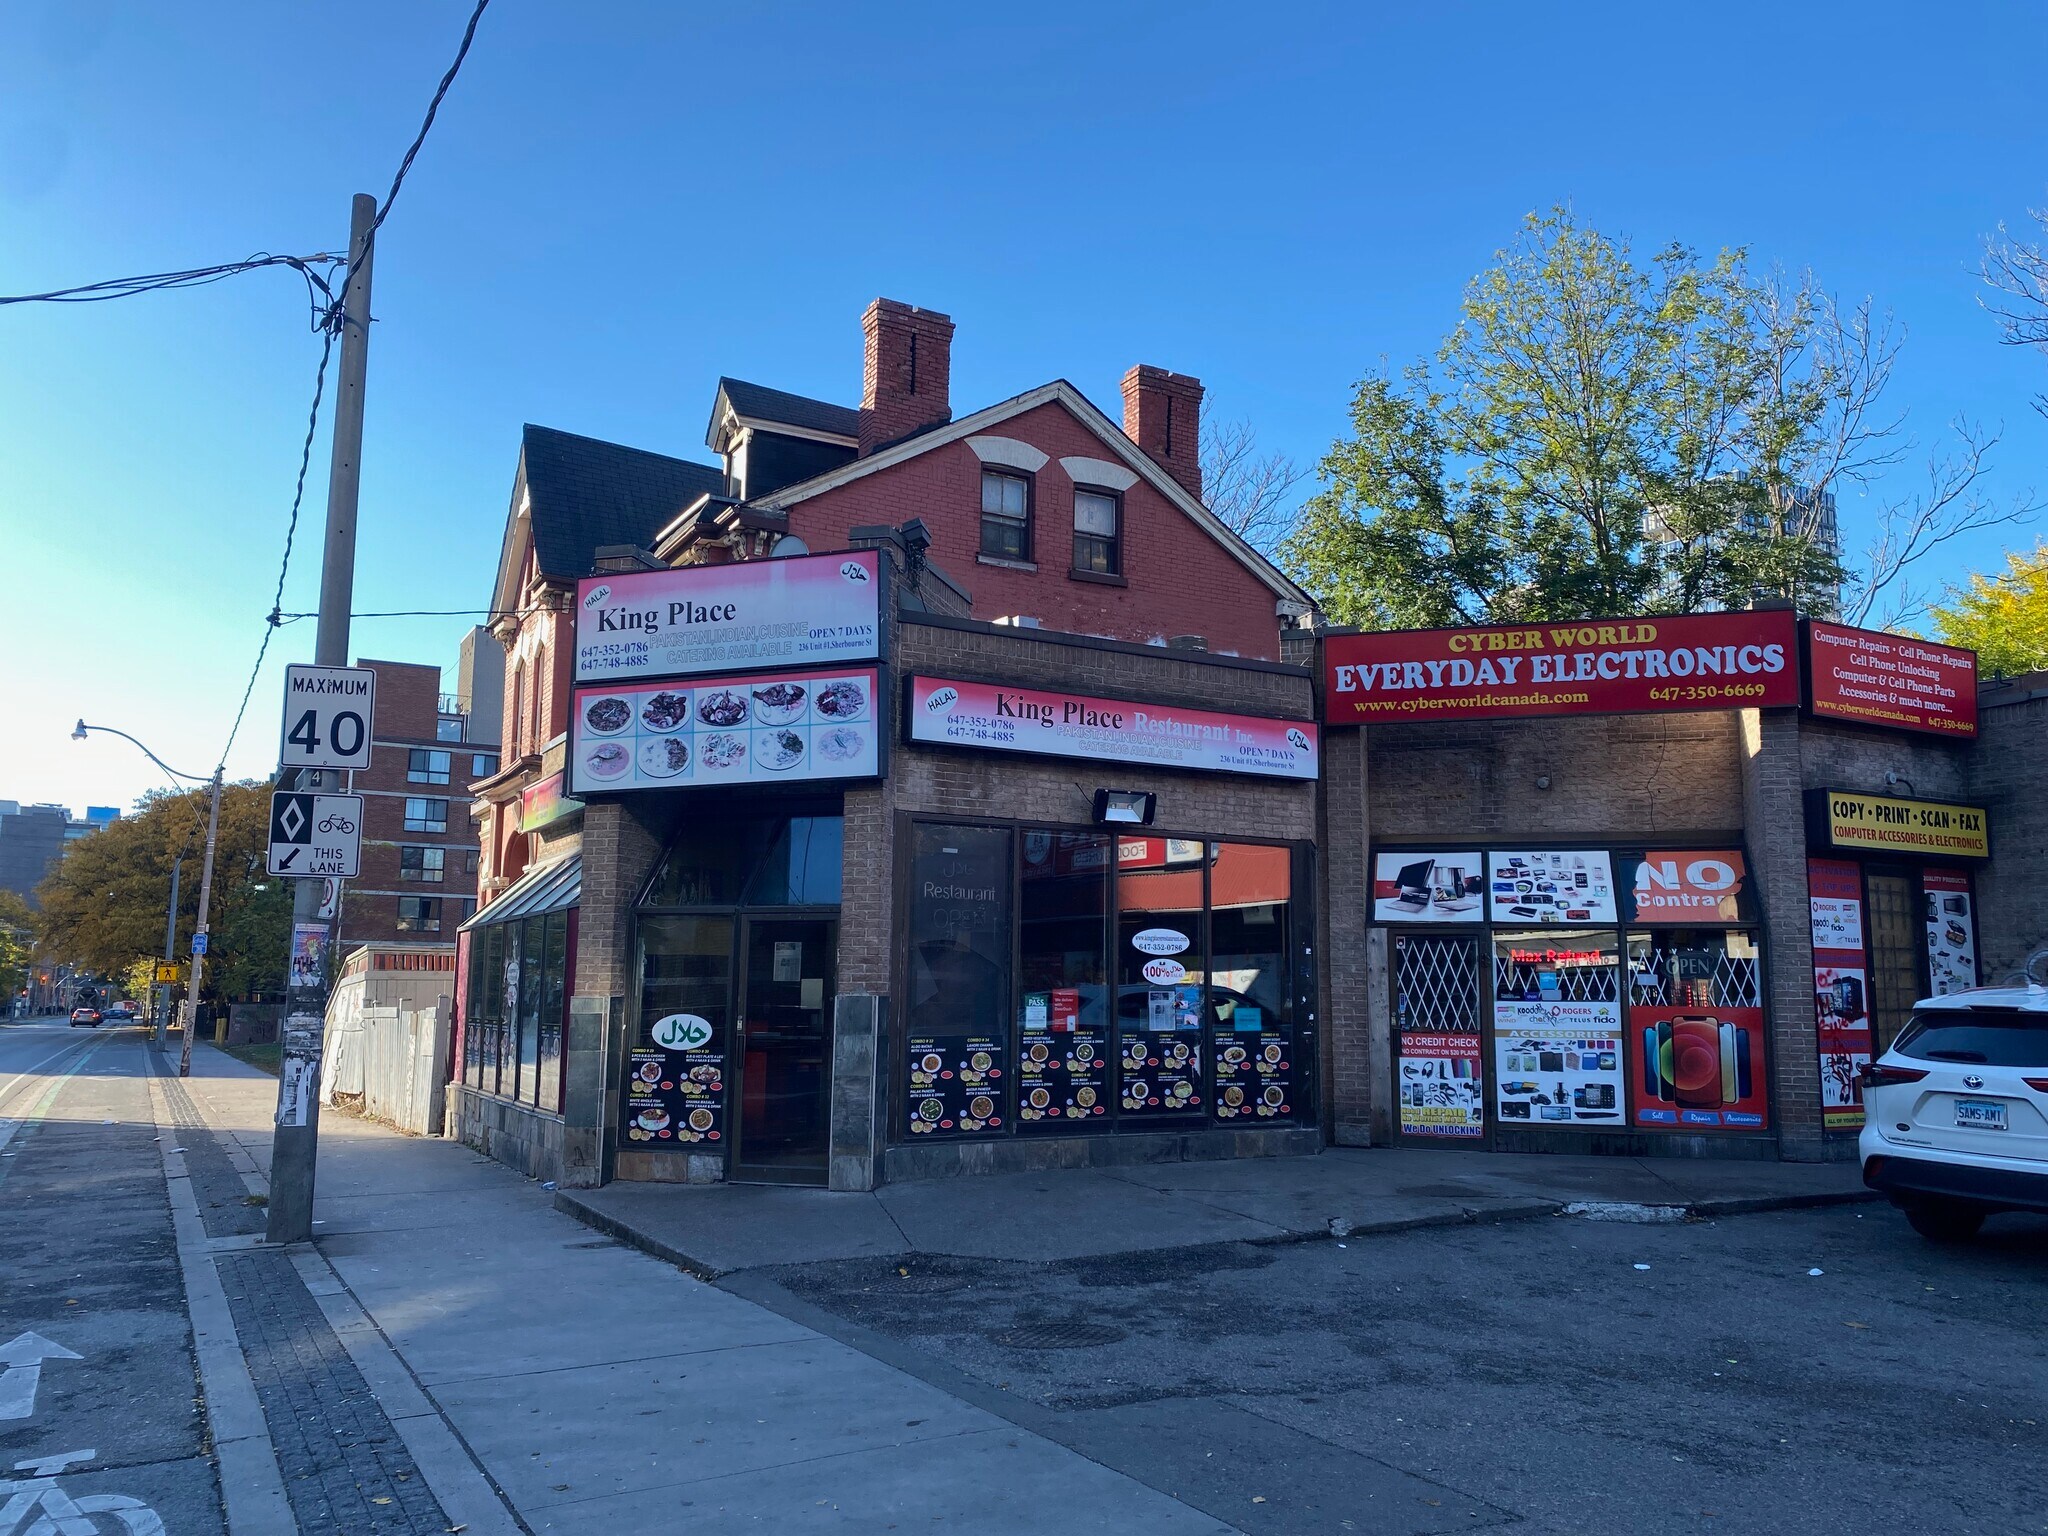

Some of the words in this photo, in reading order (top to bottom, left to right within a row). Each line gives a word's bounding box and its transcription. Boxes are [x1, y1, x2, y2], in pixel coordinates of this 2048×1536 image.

[584, 587, 610, 608] HALAL
[598, 607, 659, 634] King
[668, 602, 737, 626] Place
[809, 628, 836, 639] OPEN
[838, 627, 844, 636] 7
[845, 624, 872, 636] DAYS
[1448, 630, 1543, 654] CYBER
[1551, 624, 1657, 648] WORLD
[581, 642, 648, 658] 647-352-0786
[666, 646, 726, 664] CATERING
[727, 641, 792, 660] AVAILABLE
[799, 643, 809, 652] 236
[810, 642, 823, 650] Unit
[866, 638, 872, 646] St
[1814, 629, 1857, 648] Computer
[1858, 638, 1890, 654] Repairs
[1898, 646, 1915, 658] Cell
[1916, 648, 1941, 664] Phone
[1942, 654, 1972, 669] Repairs
[580, 655, 648, 671] 647-748-4885
[1334, 656, 1523, 693] EVERYDAY
[1530, 644, 1786, 684] ELECTRONICS
[1850, 653, 1867, 666] Cell
[1869, 656, 1896, 673] Phone
[1898, 661, 1940, 681] Unlocking
[293, 677, 368, 696] MAXIMUM
[1833, 666, 1876, 686] Computer
[1878, 674, 1887, 685] &
[1888, 676, 1906, 690] Cell
[1907, 679, 1932, 695] Phone
[1934, 683, 1956, 698] Parts
[927, 690, 956, 712] HALAL
[1649, 684, 1766, 701] 647-350-6669
[1838, 684, 1888, 703] Accessories
[1889, 693, 1897, 704] &
[1899, 694, 1923, 708] much
[1924, 701, 1953, 713] more...
[1354, 691, 1589, 714] www.cyberworldcanada.com
[947, 714, 1015, 731] 647-352-0786
[995, 693, 1054, 728] King
[1062, 701, 1123, 729] Place
[1133, 712, 1231, 742] Restaurant
[1234, 729, 1255, 744] Inc.
[1816, 700, 1921, 724] www.cyberworldcanada.com
[1928, 717, 1974, 732] 647-350-6669
[288, 709, 365, 756] 40
[947, 726, 1015, 743] 647-748-4885
[1079, 740, 1128, 756] CATERING
[1130, 746, 1183, 761] AVAILABLE
[1239, 746, 1264, 758] OPEN
[1266, 748, 1272, 759] 7
[1272, 748, 1296, 761] DAYS
[1220, 755, 1231, 764] 236
[1231, 756, 1245, 766] Unit
[1286, 761, 1296, 770] St
[312, 771, 320, 782] 4
[1833, 800, 1865, 821] COPY
[1875, 804, 1911, 826] PRINT
[1920, 809, 1950, 829] SCAN
[1959, 812, 1980, 832] FAX
[1834, 825, 1878, 842] COMPUTER
[1878, 829, 1928, 845] ACCESSORIES
[1928, 834, 1935, 846] &
[1936, 834, 1984, 850] ELECTRONICS
[314, 847, 343, 859] THIS
[309, 861, 345, 874] LANE
[1635, 860, 1736, 891] NO
[924, 881, 996, 902] Restaurant
[1819, 904, 1837, 912] ROGERS
[934, 908, 986, 929] OPEN
[1831, 924, 1845, 932] fido
[1138, 944, 1183, 952] 647-352-0786
[1511, 948, 1542, 962] Max
[1546, 948, 1600, 962] Refund
[1144, 966, 1170, 978] 100%
[1666, 958, 1710, 975] OPEN
[1593, 1016, 1616, 1024] fido
[661, 1018, 708, 1044] حلال
[1510, 1030, 1610, 1038] ACCESSORIES
[1401, 1036, 1414, 1046] NO
[1416, 1037, 1446, 1046] CREDIT
[1448, 1038, 1478, 1048] CHECK
[1422, 1107, 1467, 1117] REPAIR
[1652, 1112, 1664, 1120] Sell
[1690, 1113, 1711, 1123] Repair
[1726, 1113, 1761, 1123] Accessories
[1404, 1124, 1417, 1133] We
[1420, 1124, 1431, 1134] Do
[1433, 1125, 1481, 1136] UNLOCKING
